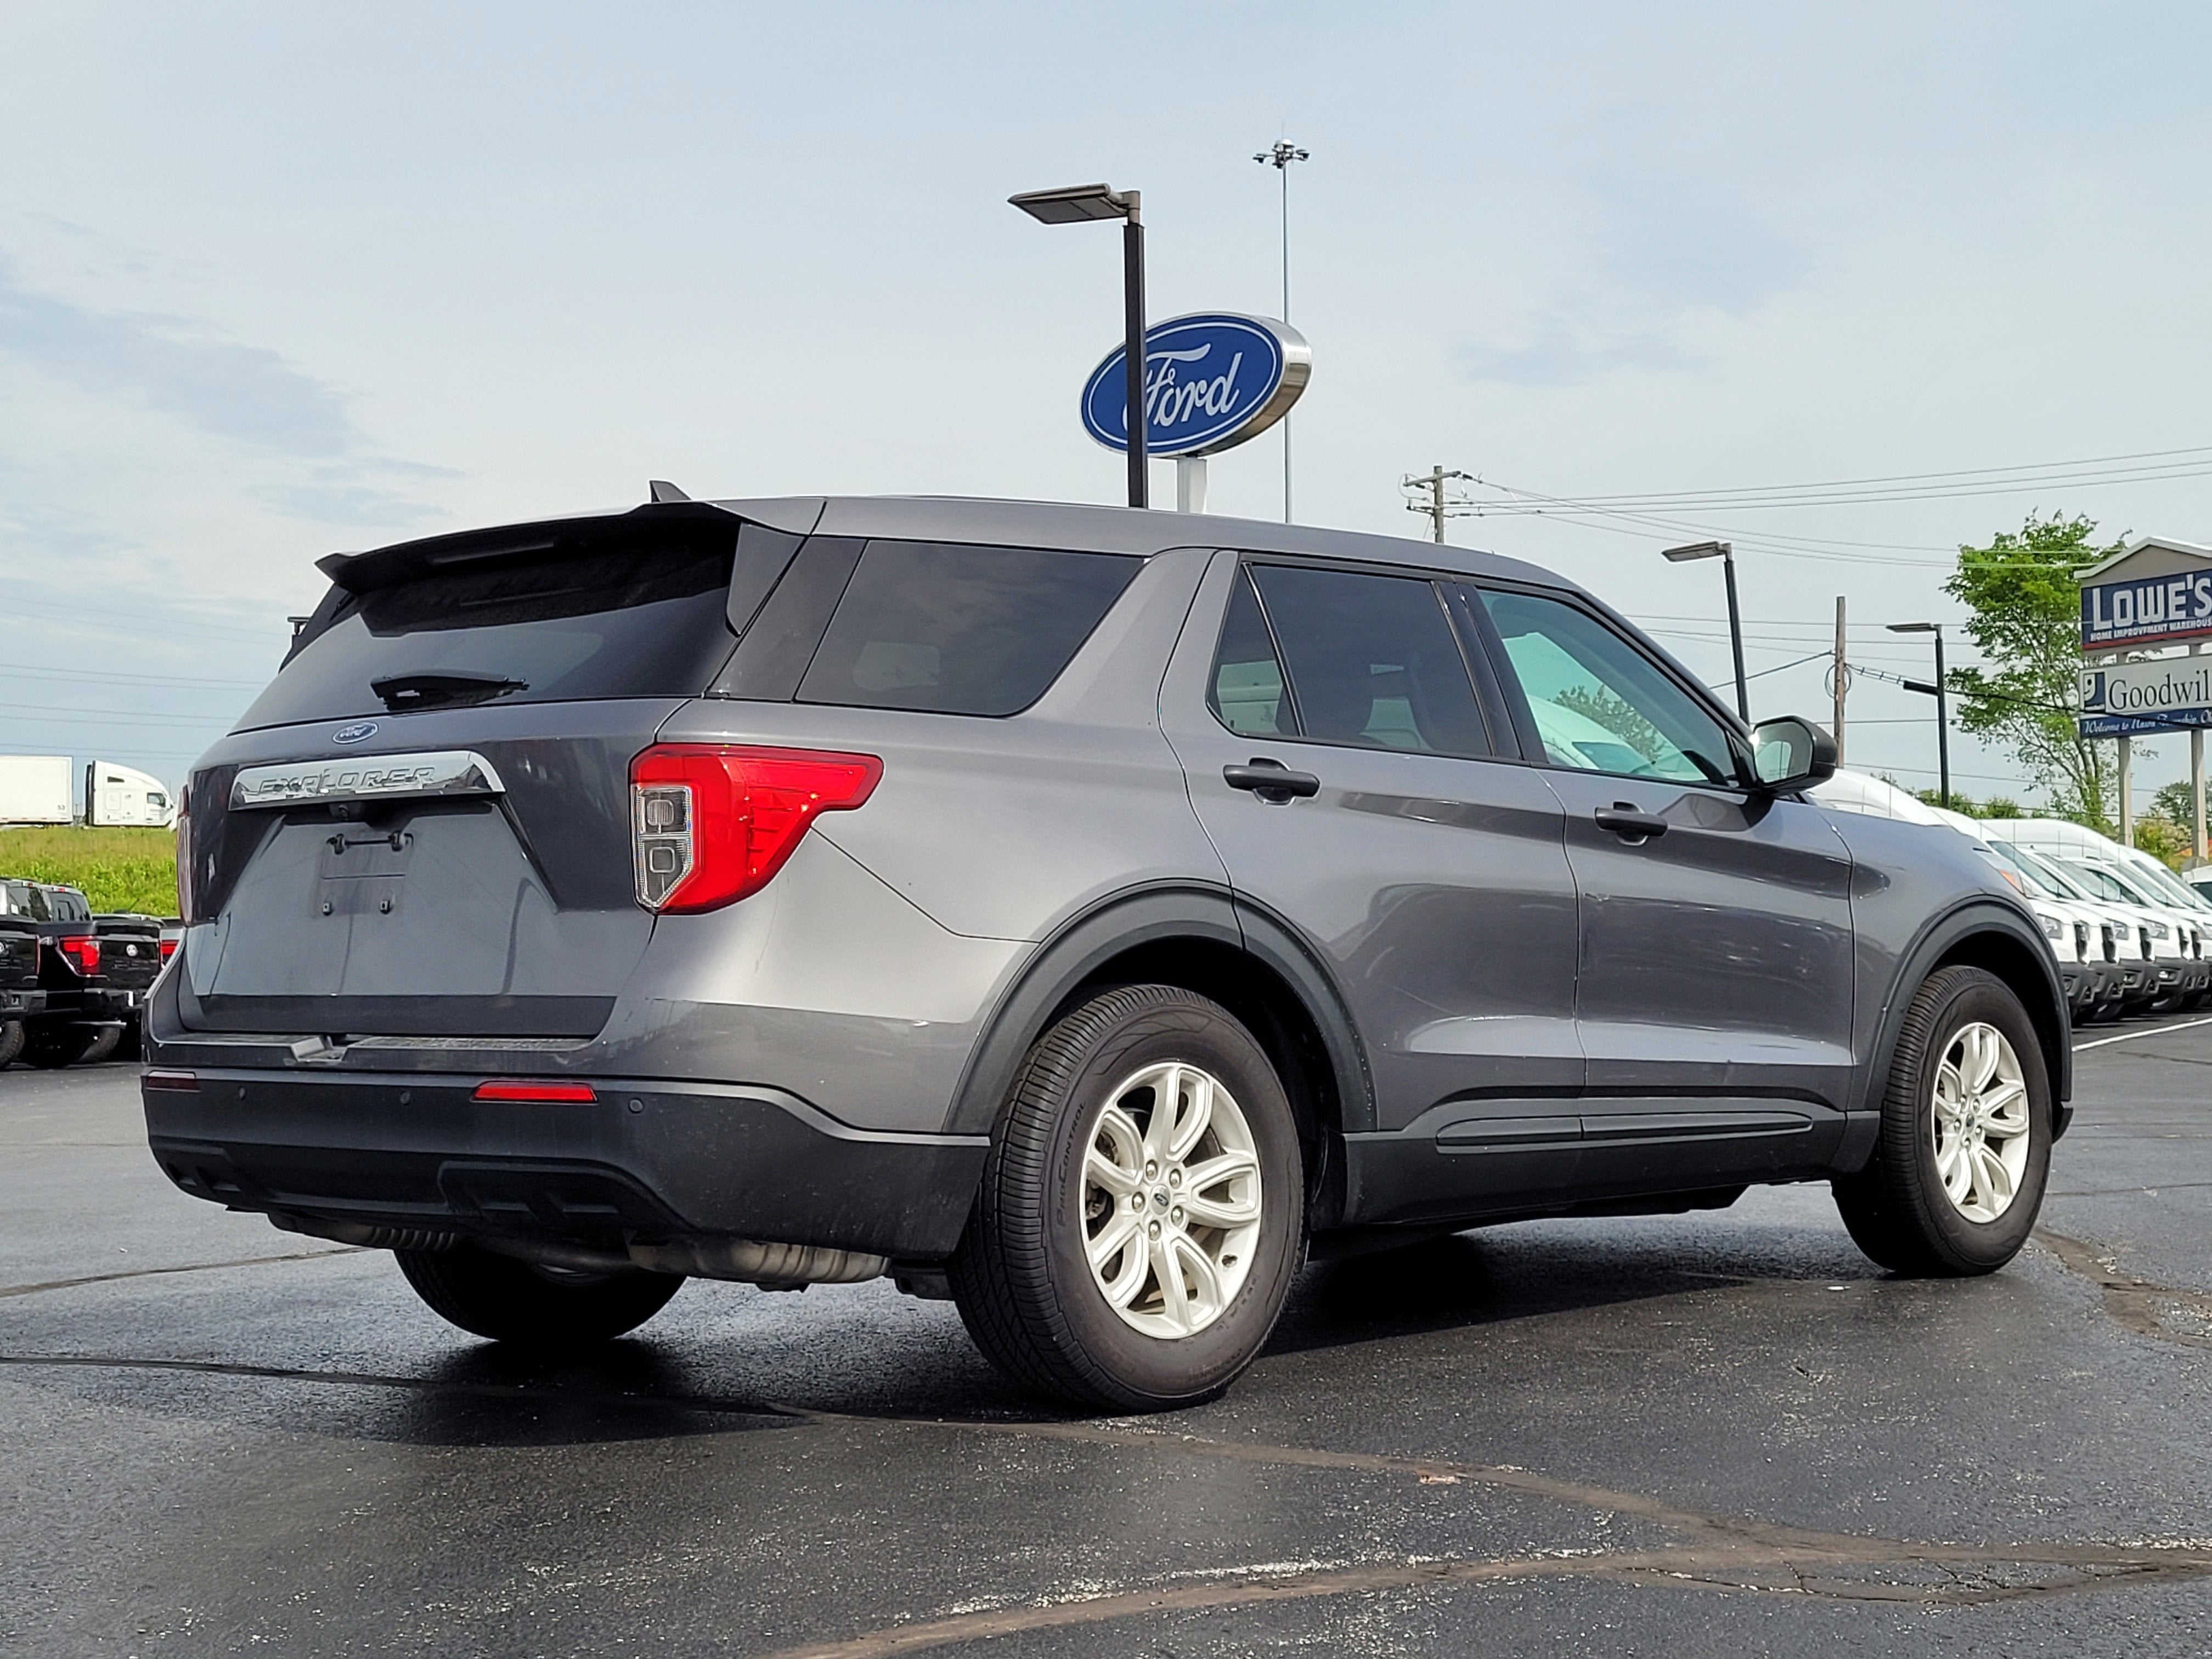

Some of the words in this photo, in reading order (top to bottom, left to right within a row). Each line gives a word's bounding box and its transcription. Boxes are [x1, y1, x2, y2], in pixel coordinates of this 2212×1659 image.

[1122, 343, 1243, 431] Ford
[2092, 573, 2212, 631] LOWE'S
[2169, 617, 2212, 631] WAREHOUS
[2109, 668, 2212, 710] Goodwil
[258, 766, 436, 795] EXPLORER
